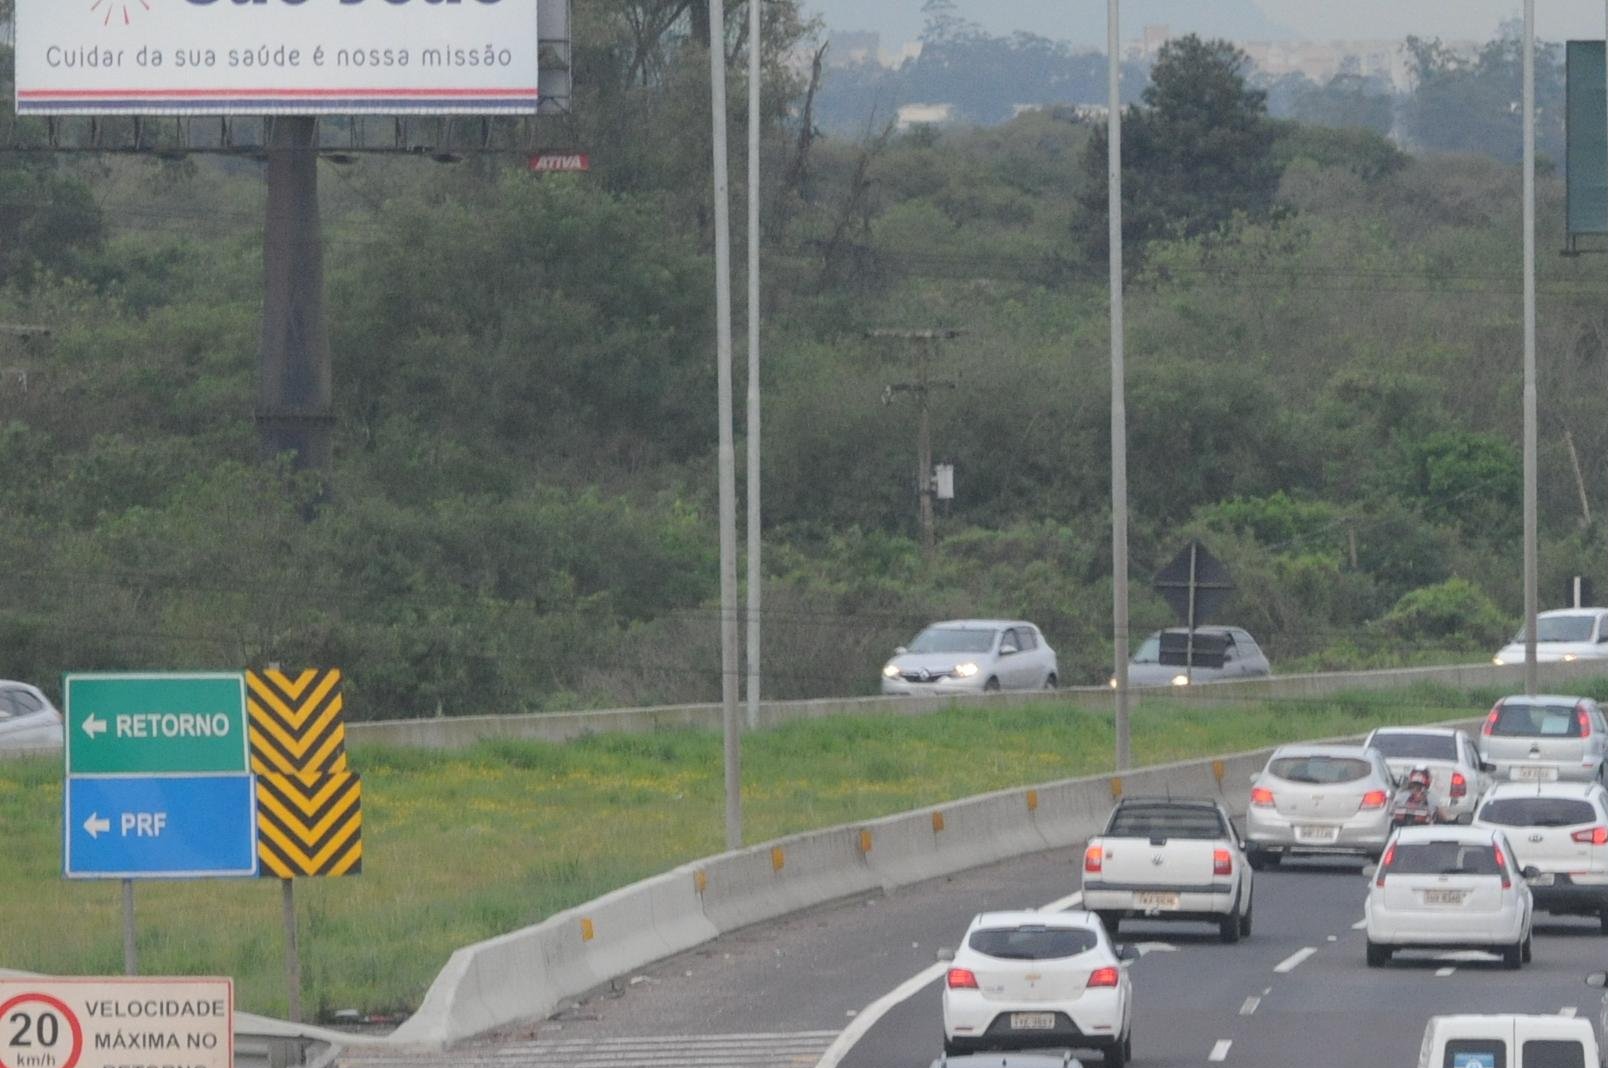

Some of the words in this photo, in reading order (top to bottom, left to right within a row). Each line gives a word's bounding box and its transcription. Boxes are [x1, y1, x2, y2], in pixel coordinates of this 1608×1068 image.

[46, 44, 124, 68] Cuidar
[136, 45, 163, 67] da
[175, 49, 217, 67] sua
[228, 44, 300, 67] saúde
[312, 45, 325, 66] é
[338, 47, 410, 67] nossa
[422, 44, 512, 67] missão
[116, 713, 230, 738] RETORNO
[120, 812, 168, 838] PRF
[85, 1000, 225, 1018] VELOCIDADE
[8, 1012, 59, 1047] 20
[95, 1029, 180, 1050] MÁXIMA
[187, 1033, 218, 1049] NO
[16, 1053, 56, 1068] km/h
